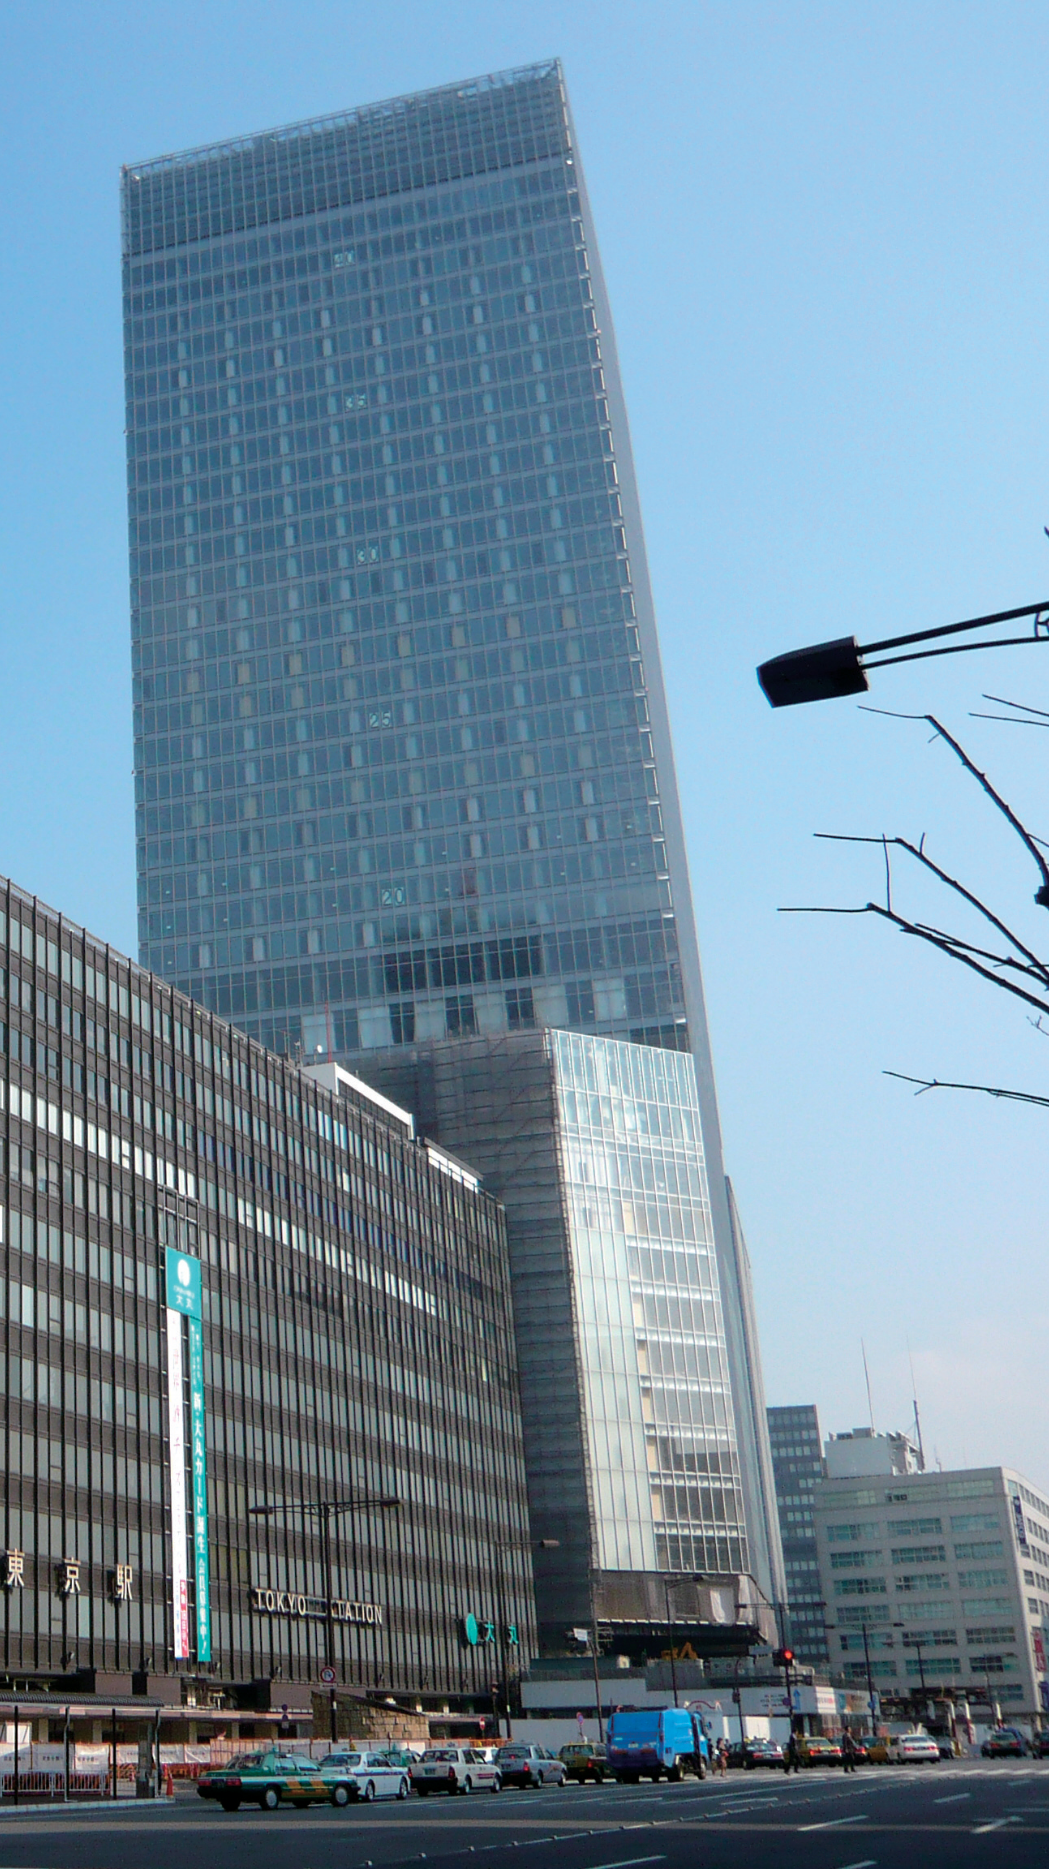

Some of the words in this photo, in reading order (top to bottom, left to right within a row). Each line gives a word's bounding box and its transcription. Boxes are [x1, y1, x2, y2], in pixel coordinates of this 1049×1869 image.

[368, 710, 391, 728] 25
[382, 887, 405, 906] 20
[6, 1547, 133, 1601] 東京駅
[255, 1588, 307, 1616] TOKYO
[485, 1620, 520, 1645] 大丸
